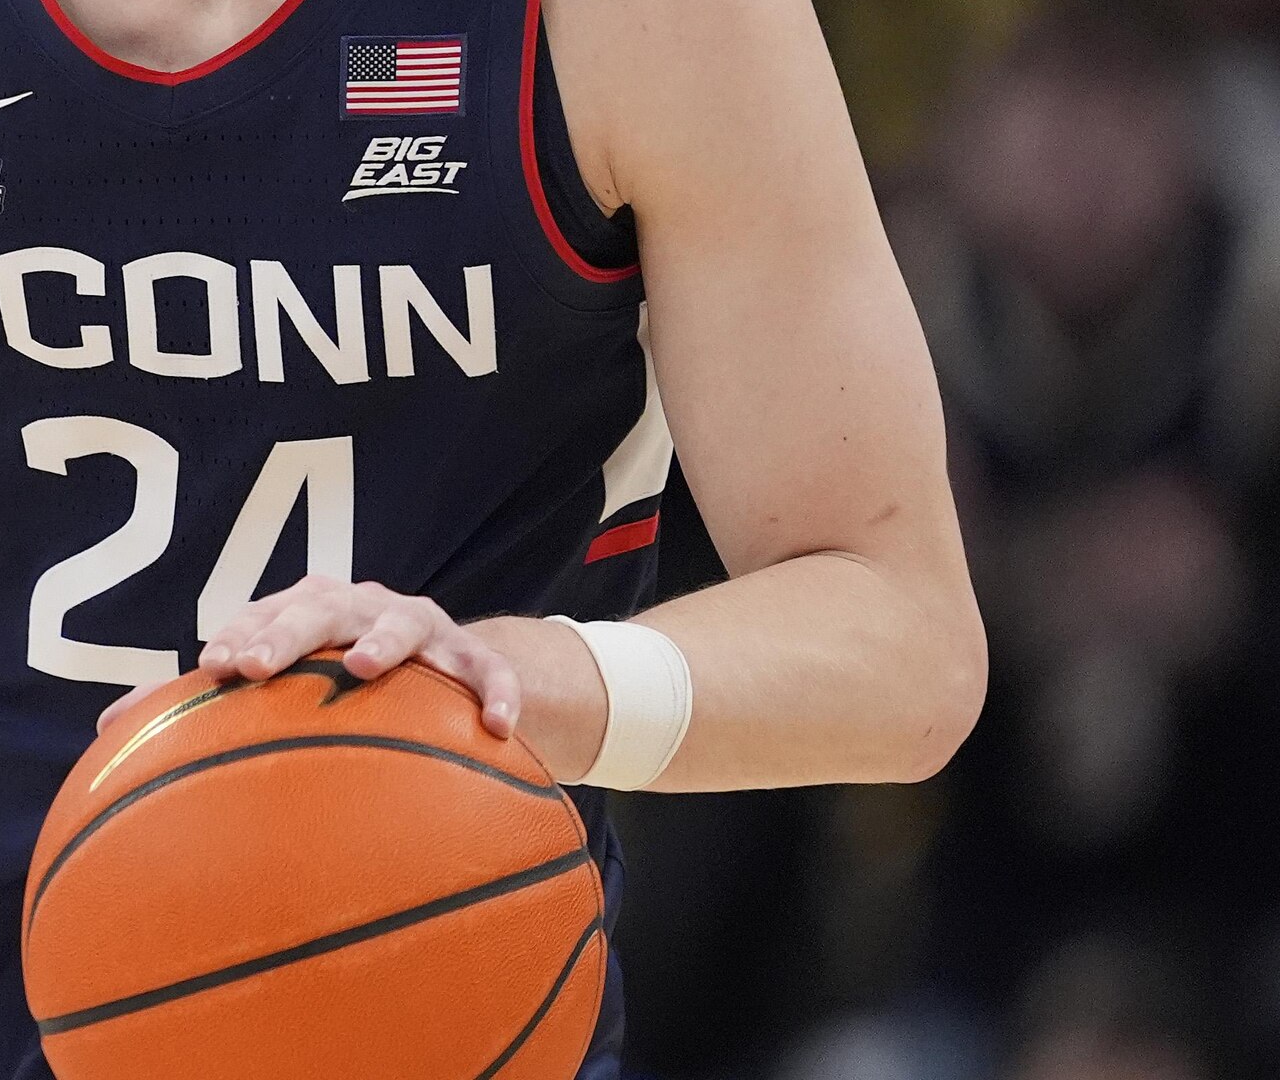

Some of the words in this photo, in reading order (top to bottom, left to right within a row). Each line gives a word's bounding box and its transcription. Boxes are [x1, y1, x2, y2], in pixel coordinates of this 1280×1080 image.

[361, 135, 448, 162] BIG
[349, 161, 468, 186] EAST
[20, 415, 355, 687] 24
